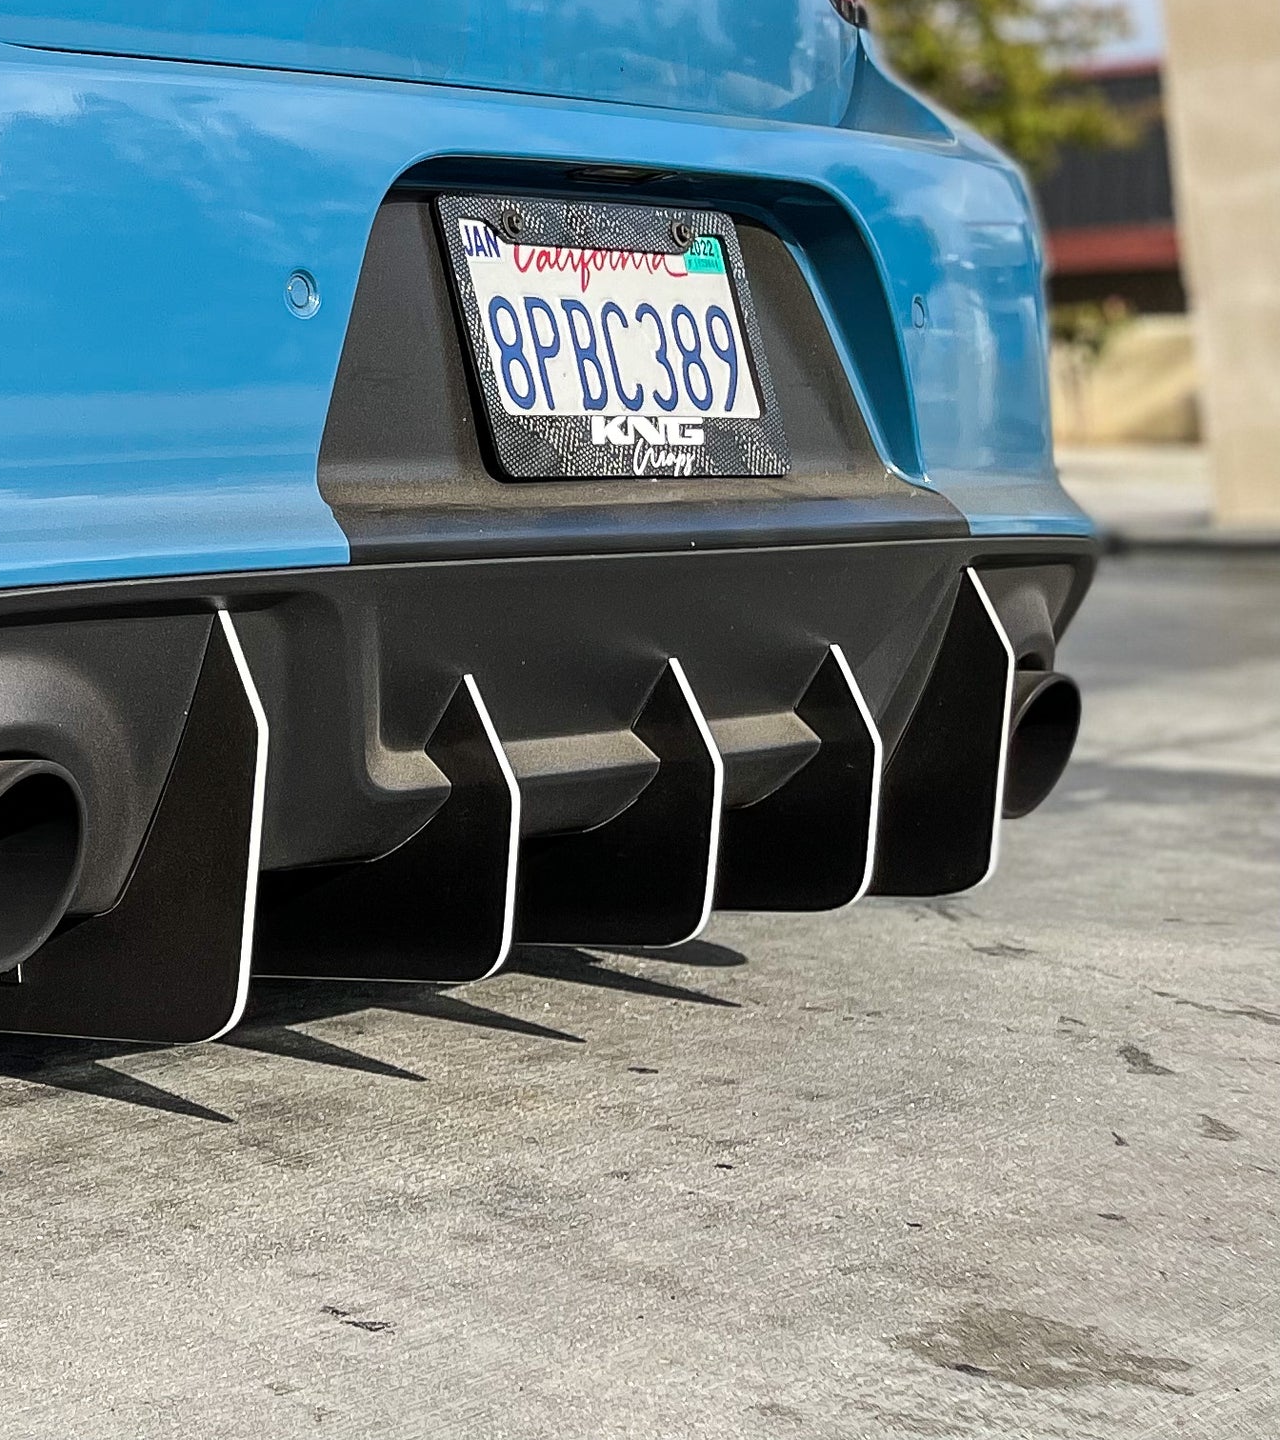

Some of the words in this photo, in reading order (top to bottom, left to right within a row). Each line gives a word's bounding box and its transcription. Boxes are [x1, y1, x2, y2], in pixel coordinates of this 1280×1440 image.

[464, 224, 501, 259] JAN
[487, 295, 739, 412] 8PBC389
[591, 416, 705, 445] KNG
